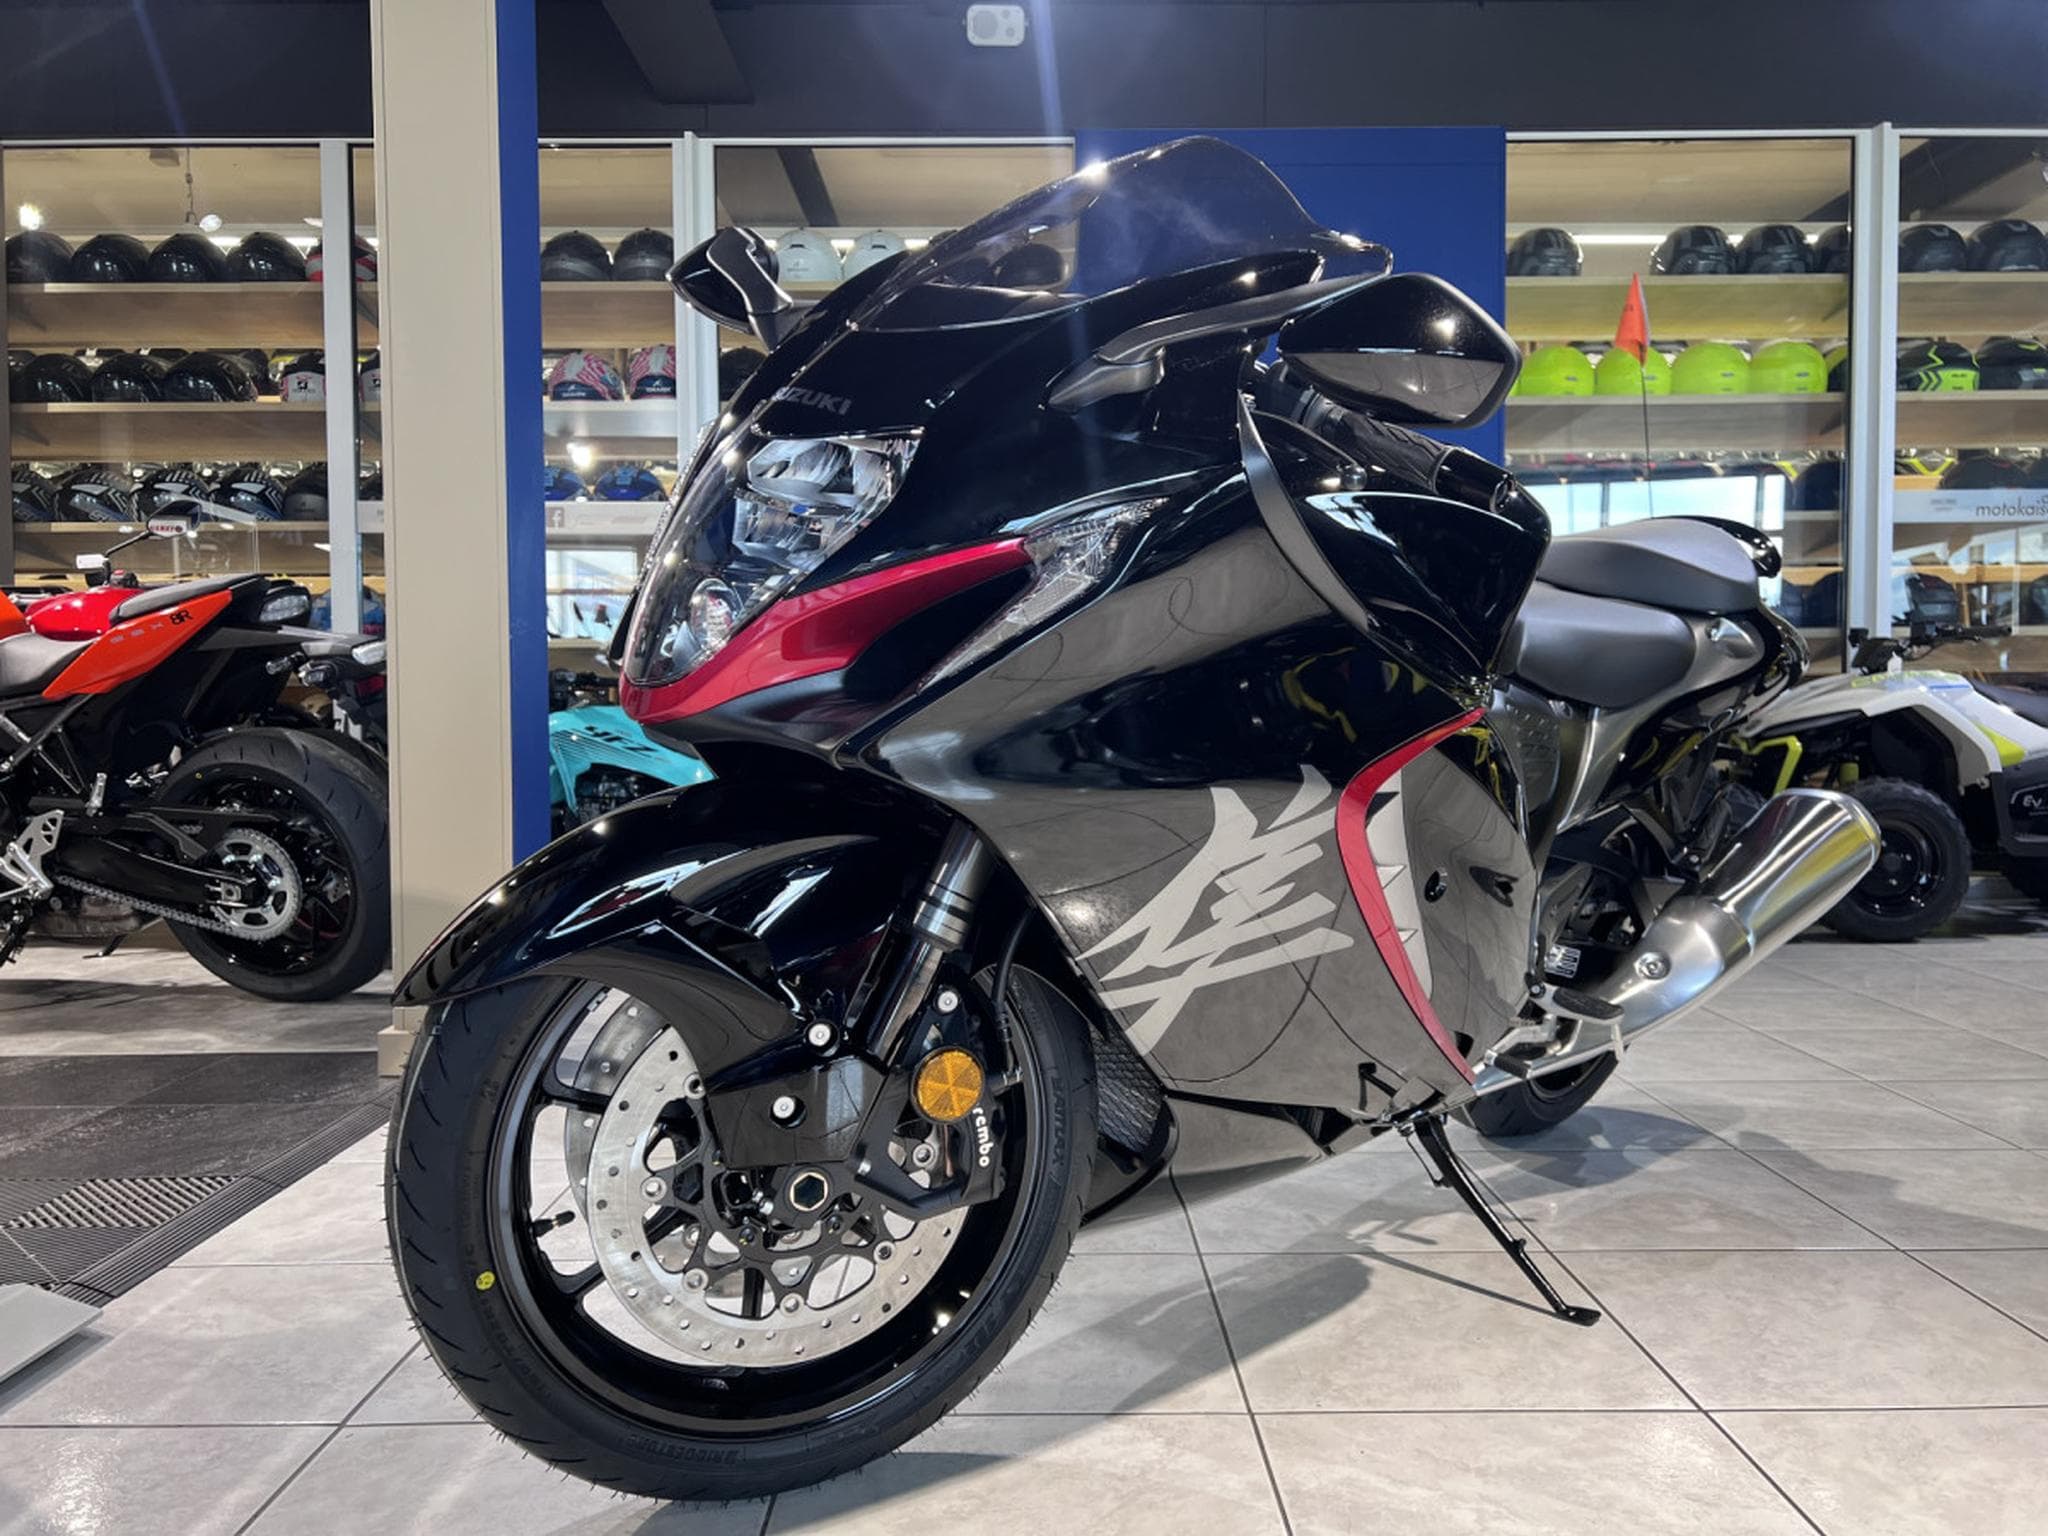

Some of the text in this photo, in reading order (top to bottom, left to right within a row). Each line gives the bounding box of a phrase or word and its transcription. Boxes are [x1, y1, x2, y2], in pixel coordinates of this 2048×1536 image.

[774, 386, 852, 415] UZUKI
[1976, 495, 2048, 516] motokais
[972, 1103, 994, 1168] rembo
